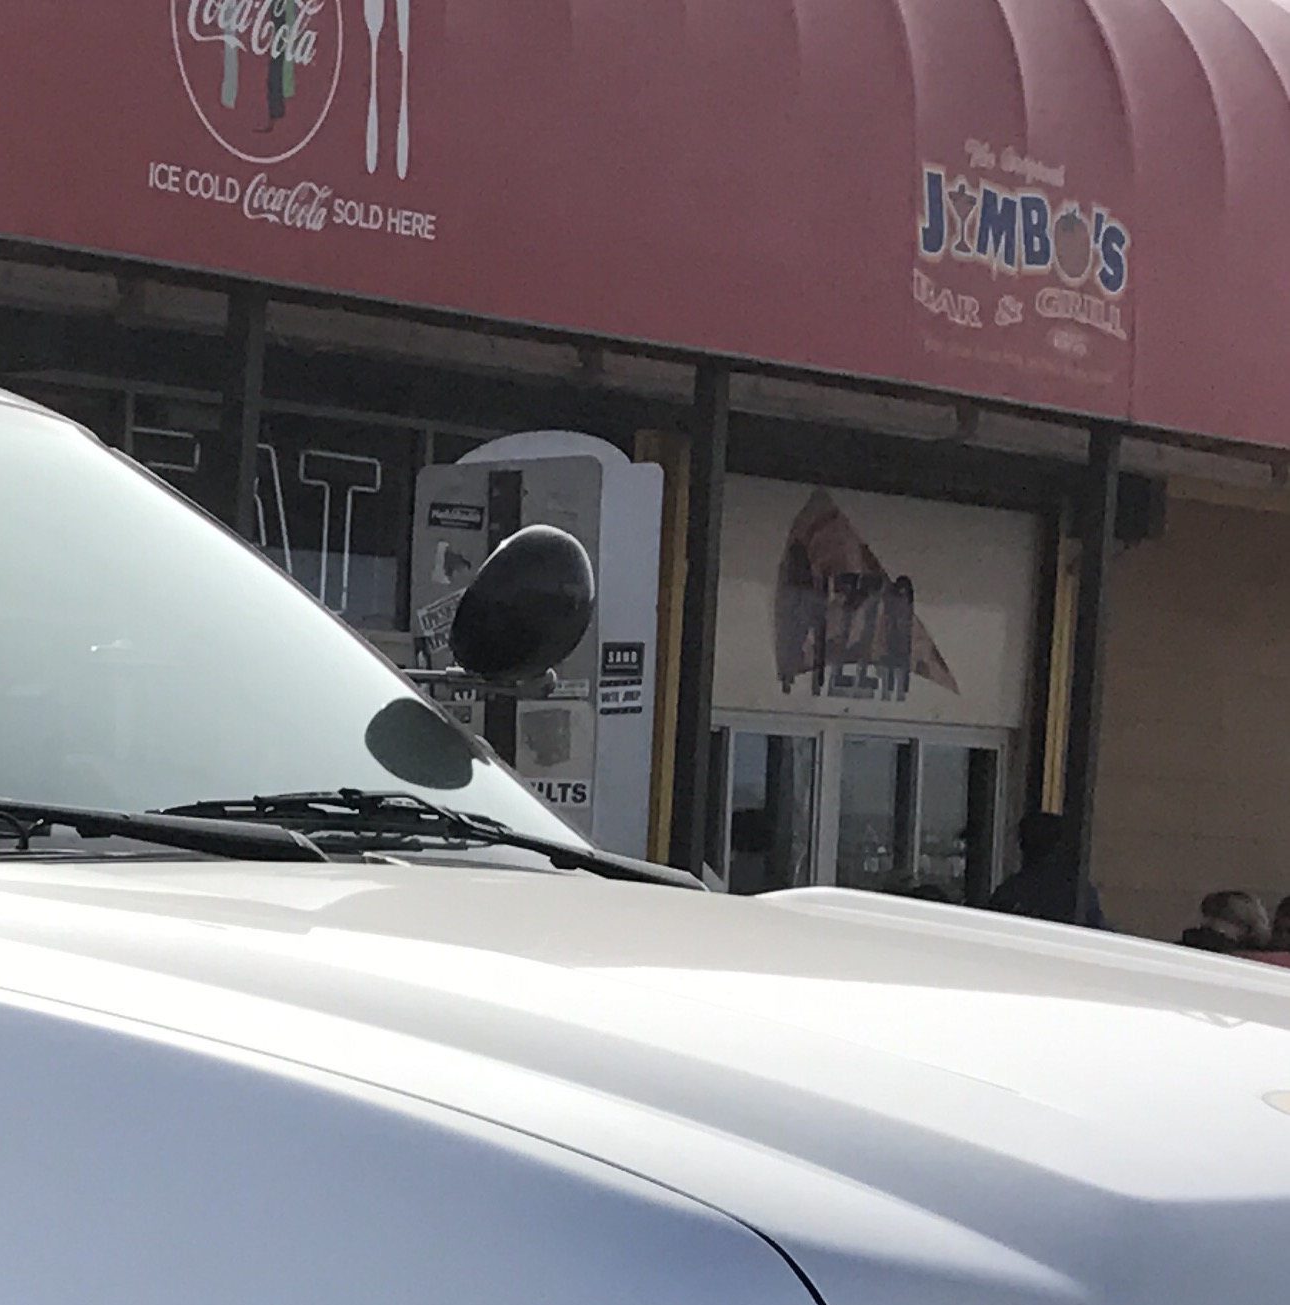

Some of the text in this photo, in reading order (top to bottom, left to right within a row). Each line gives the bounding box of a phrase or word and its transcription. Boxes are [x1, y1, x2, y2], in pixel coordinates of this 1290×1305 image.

[148, 162, 181, 192] ICE
[185, 170, 240, 204] COLD
[332, 199, 383, 230] SOLD
[386, 208, 437, 240] HERE
